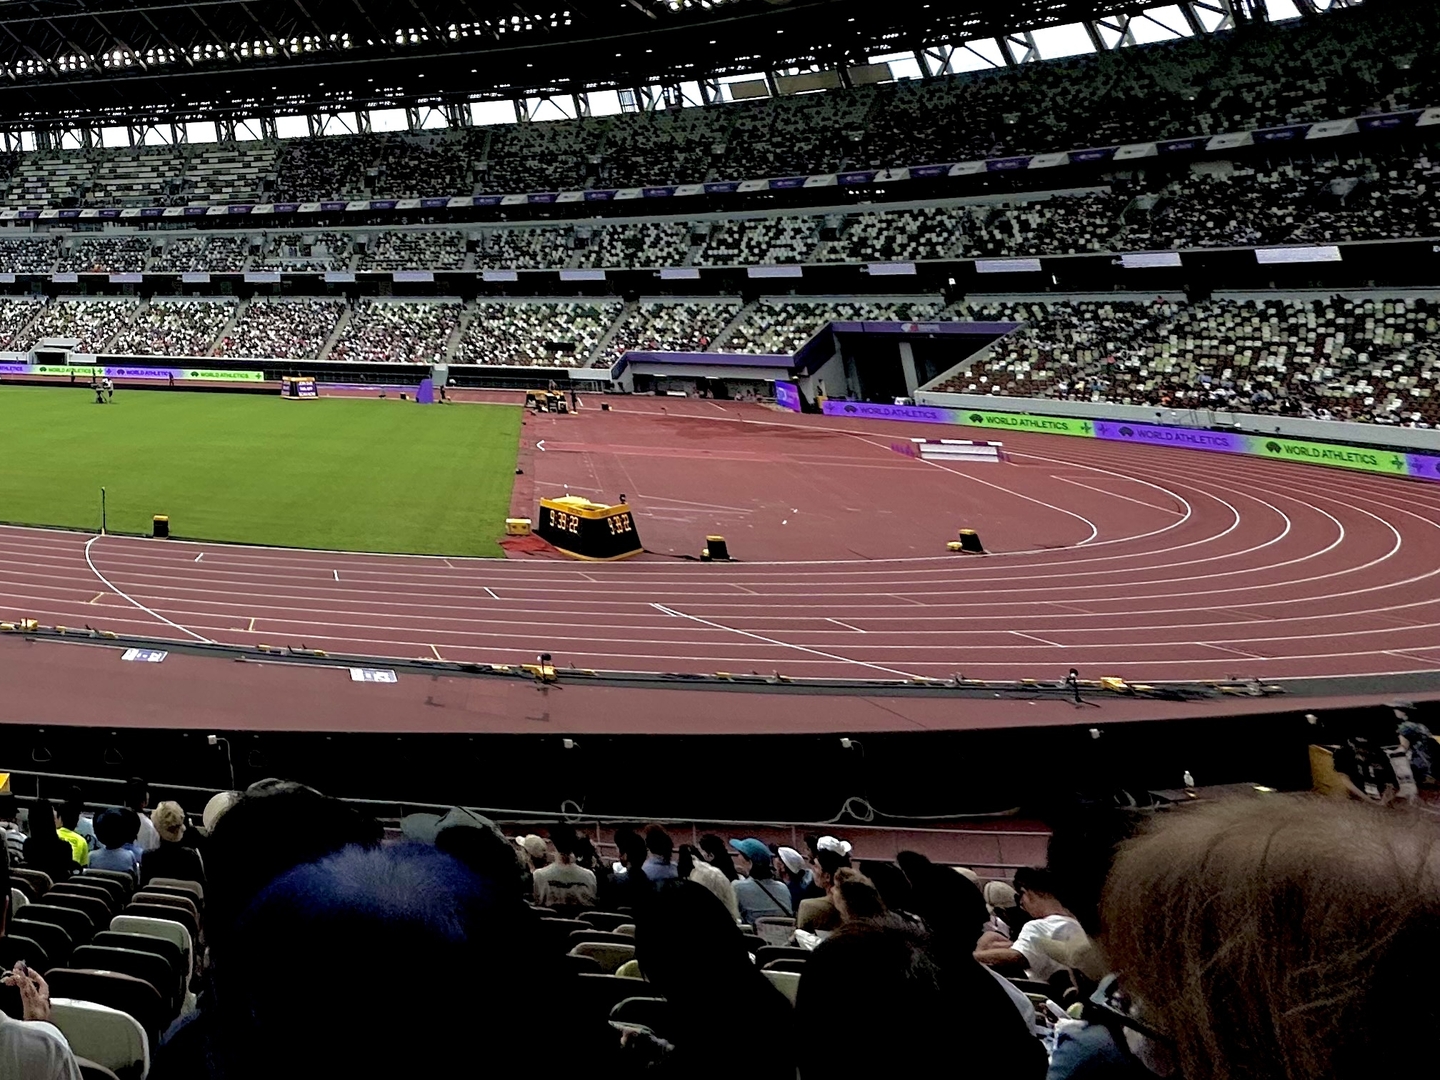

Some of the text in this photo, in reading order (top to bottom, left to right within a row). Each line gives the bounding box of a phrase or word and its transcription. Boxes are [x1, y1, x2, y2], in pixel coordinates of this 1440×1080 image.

[860, 406, 937, 420] WORLD ATHLETICS
[986, 415, 1069, 431] WORLD ATHLETICS
[1137, 428, 1230, 447] WORLD ATHLETICS
[1283, 444, 1378, 466] WORLD ATHLETICS
